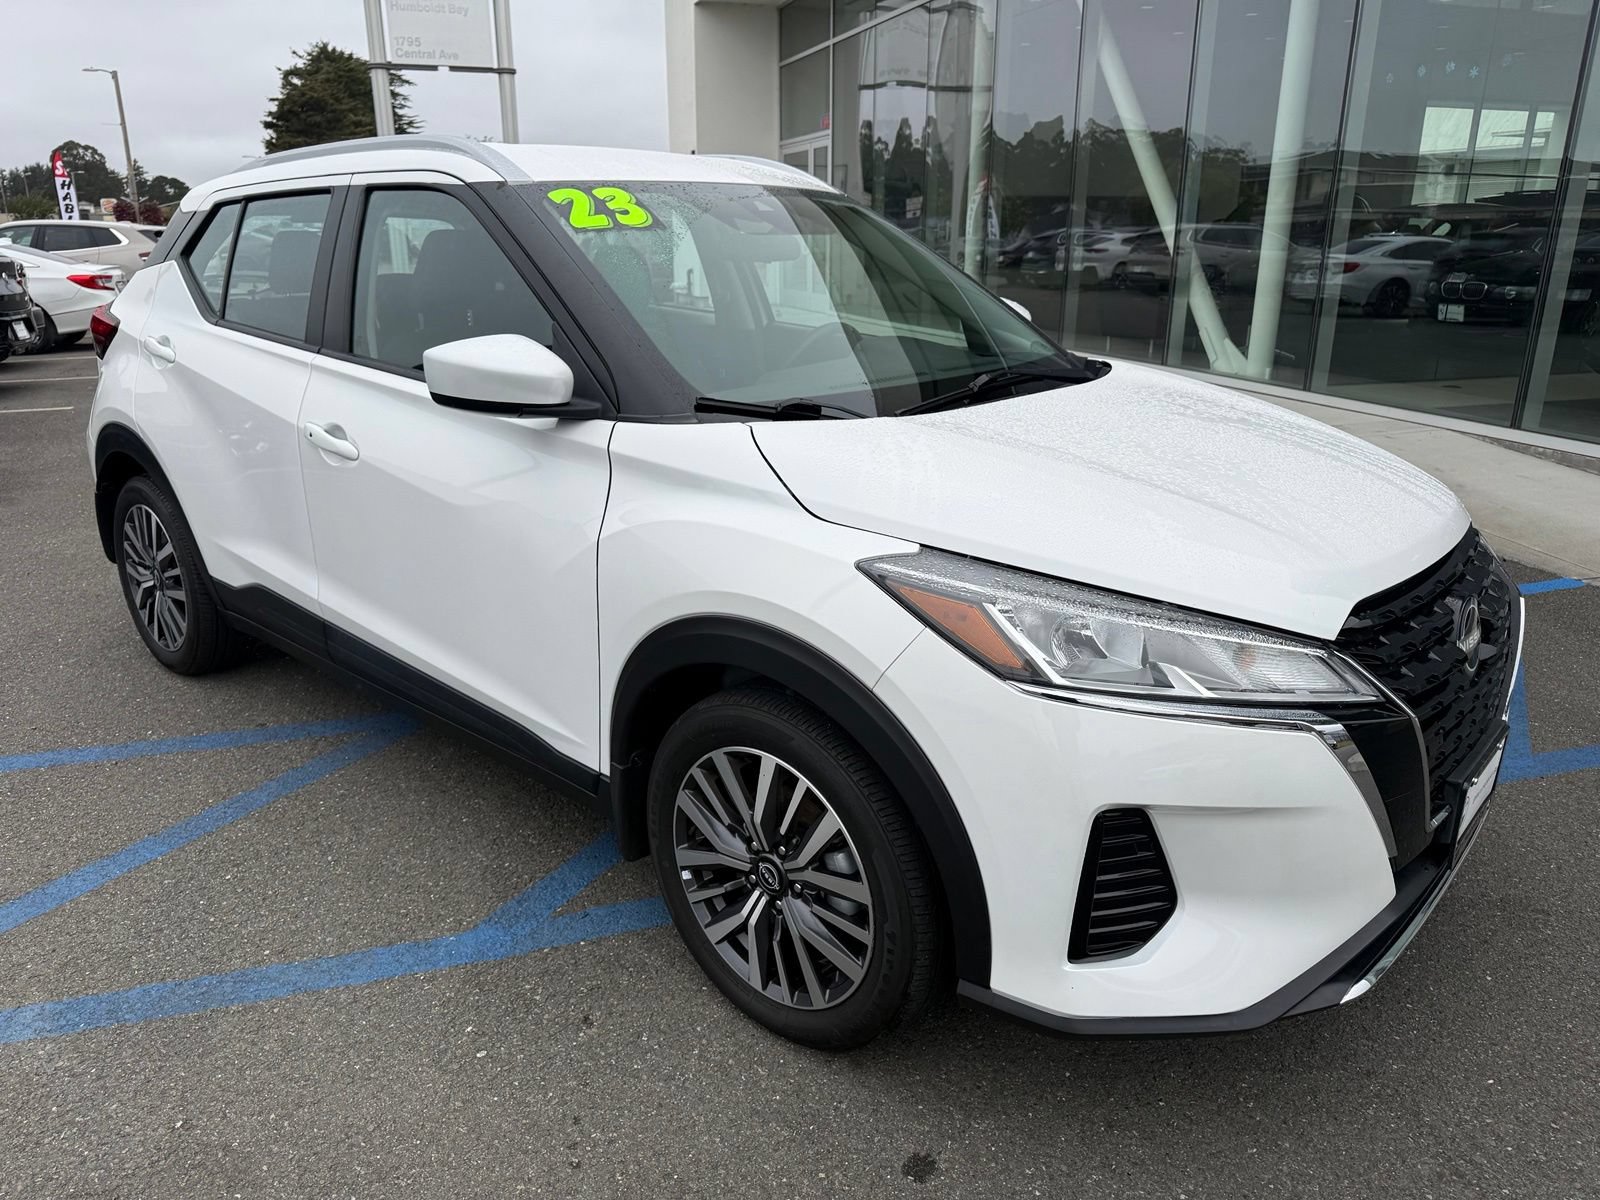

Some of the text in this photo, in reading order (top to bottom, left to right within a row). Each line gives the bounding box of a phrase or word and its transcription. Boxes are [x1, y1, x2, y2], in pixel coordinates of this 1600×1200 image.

[390, 0, 470, 17] Humboldt Bay
[394, 36, 422, 48] 1795
[395, 47, 460, 61] Central Ave
[546, 187, 653, 230] 23
[1457, 630, 1480, 652] NISS
